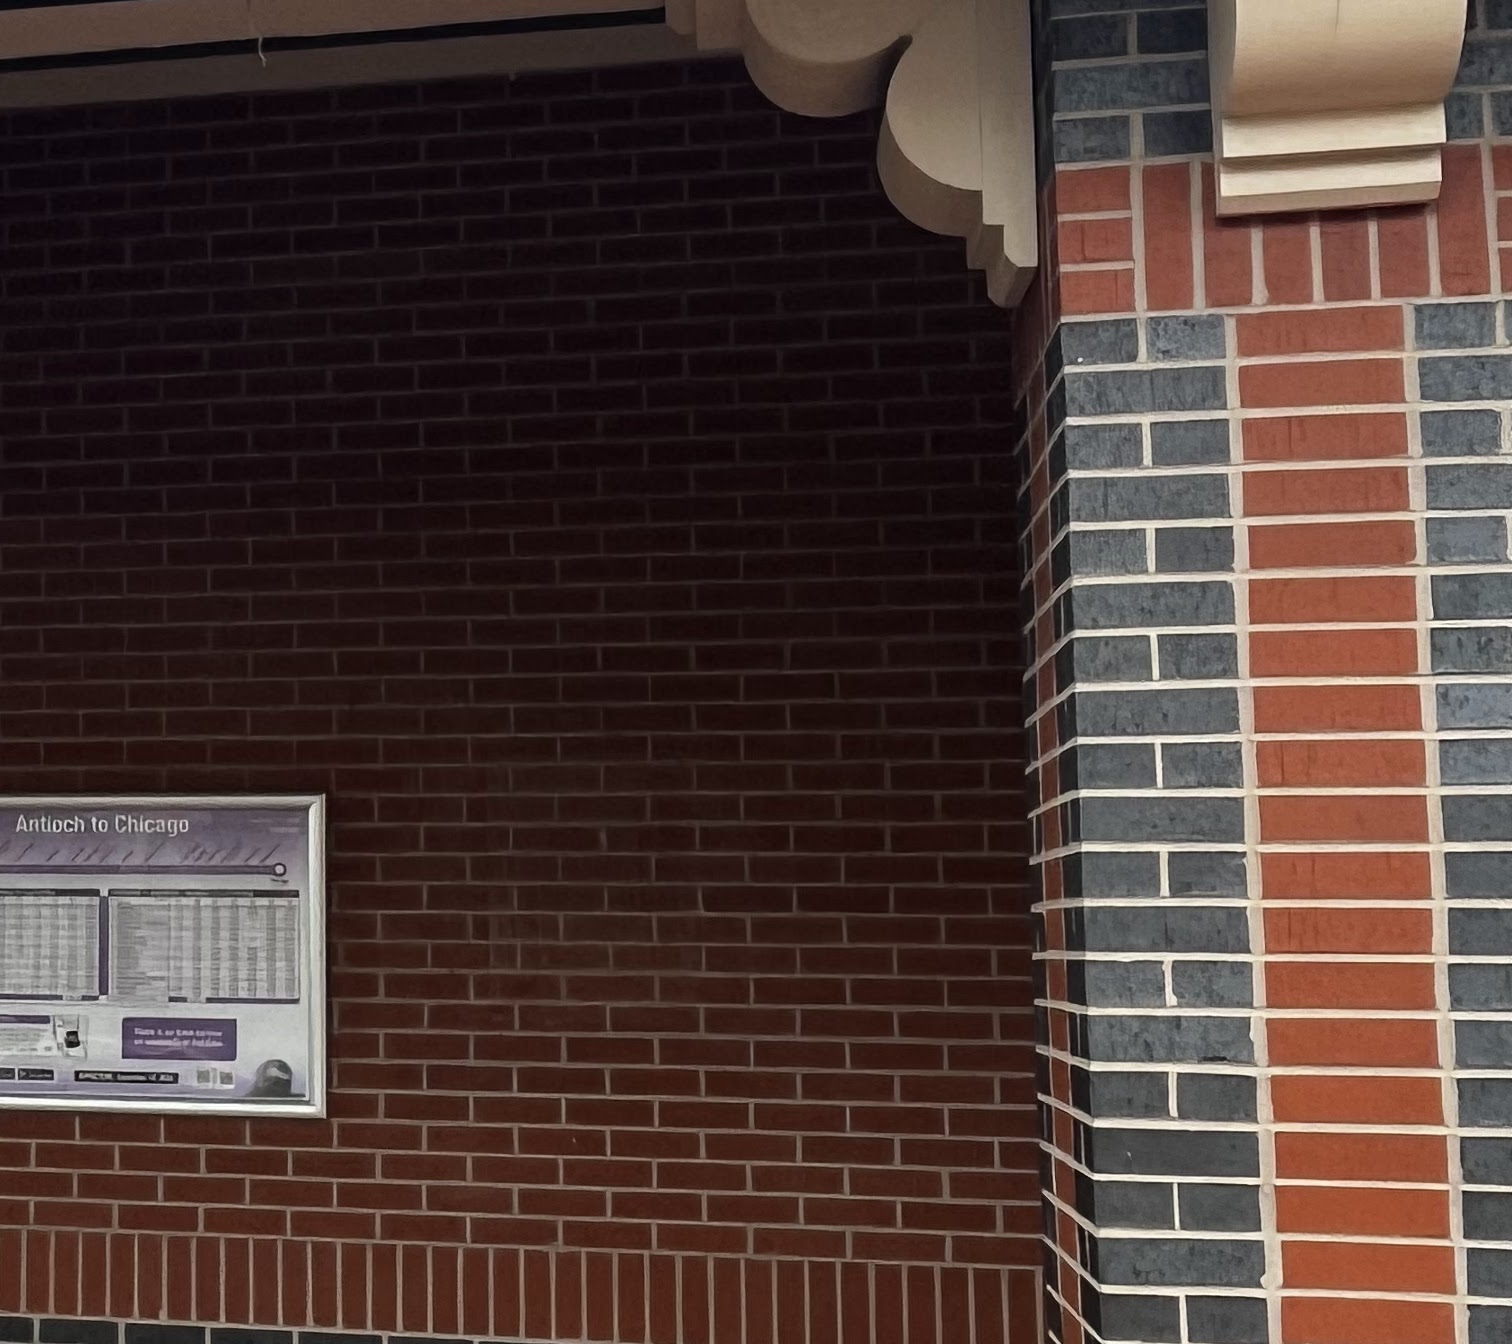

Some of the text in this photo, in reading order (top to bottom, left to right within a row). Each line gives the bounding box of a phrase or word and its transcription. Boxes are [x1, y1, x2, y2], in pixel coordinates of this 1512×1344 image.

[15, 814, 189, 837] Antioch to Chicago
